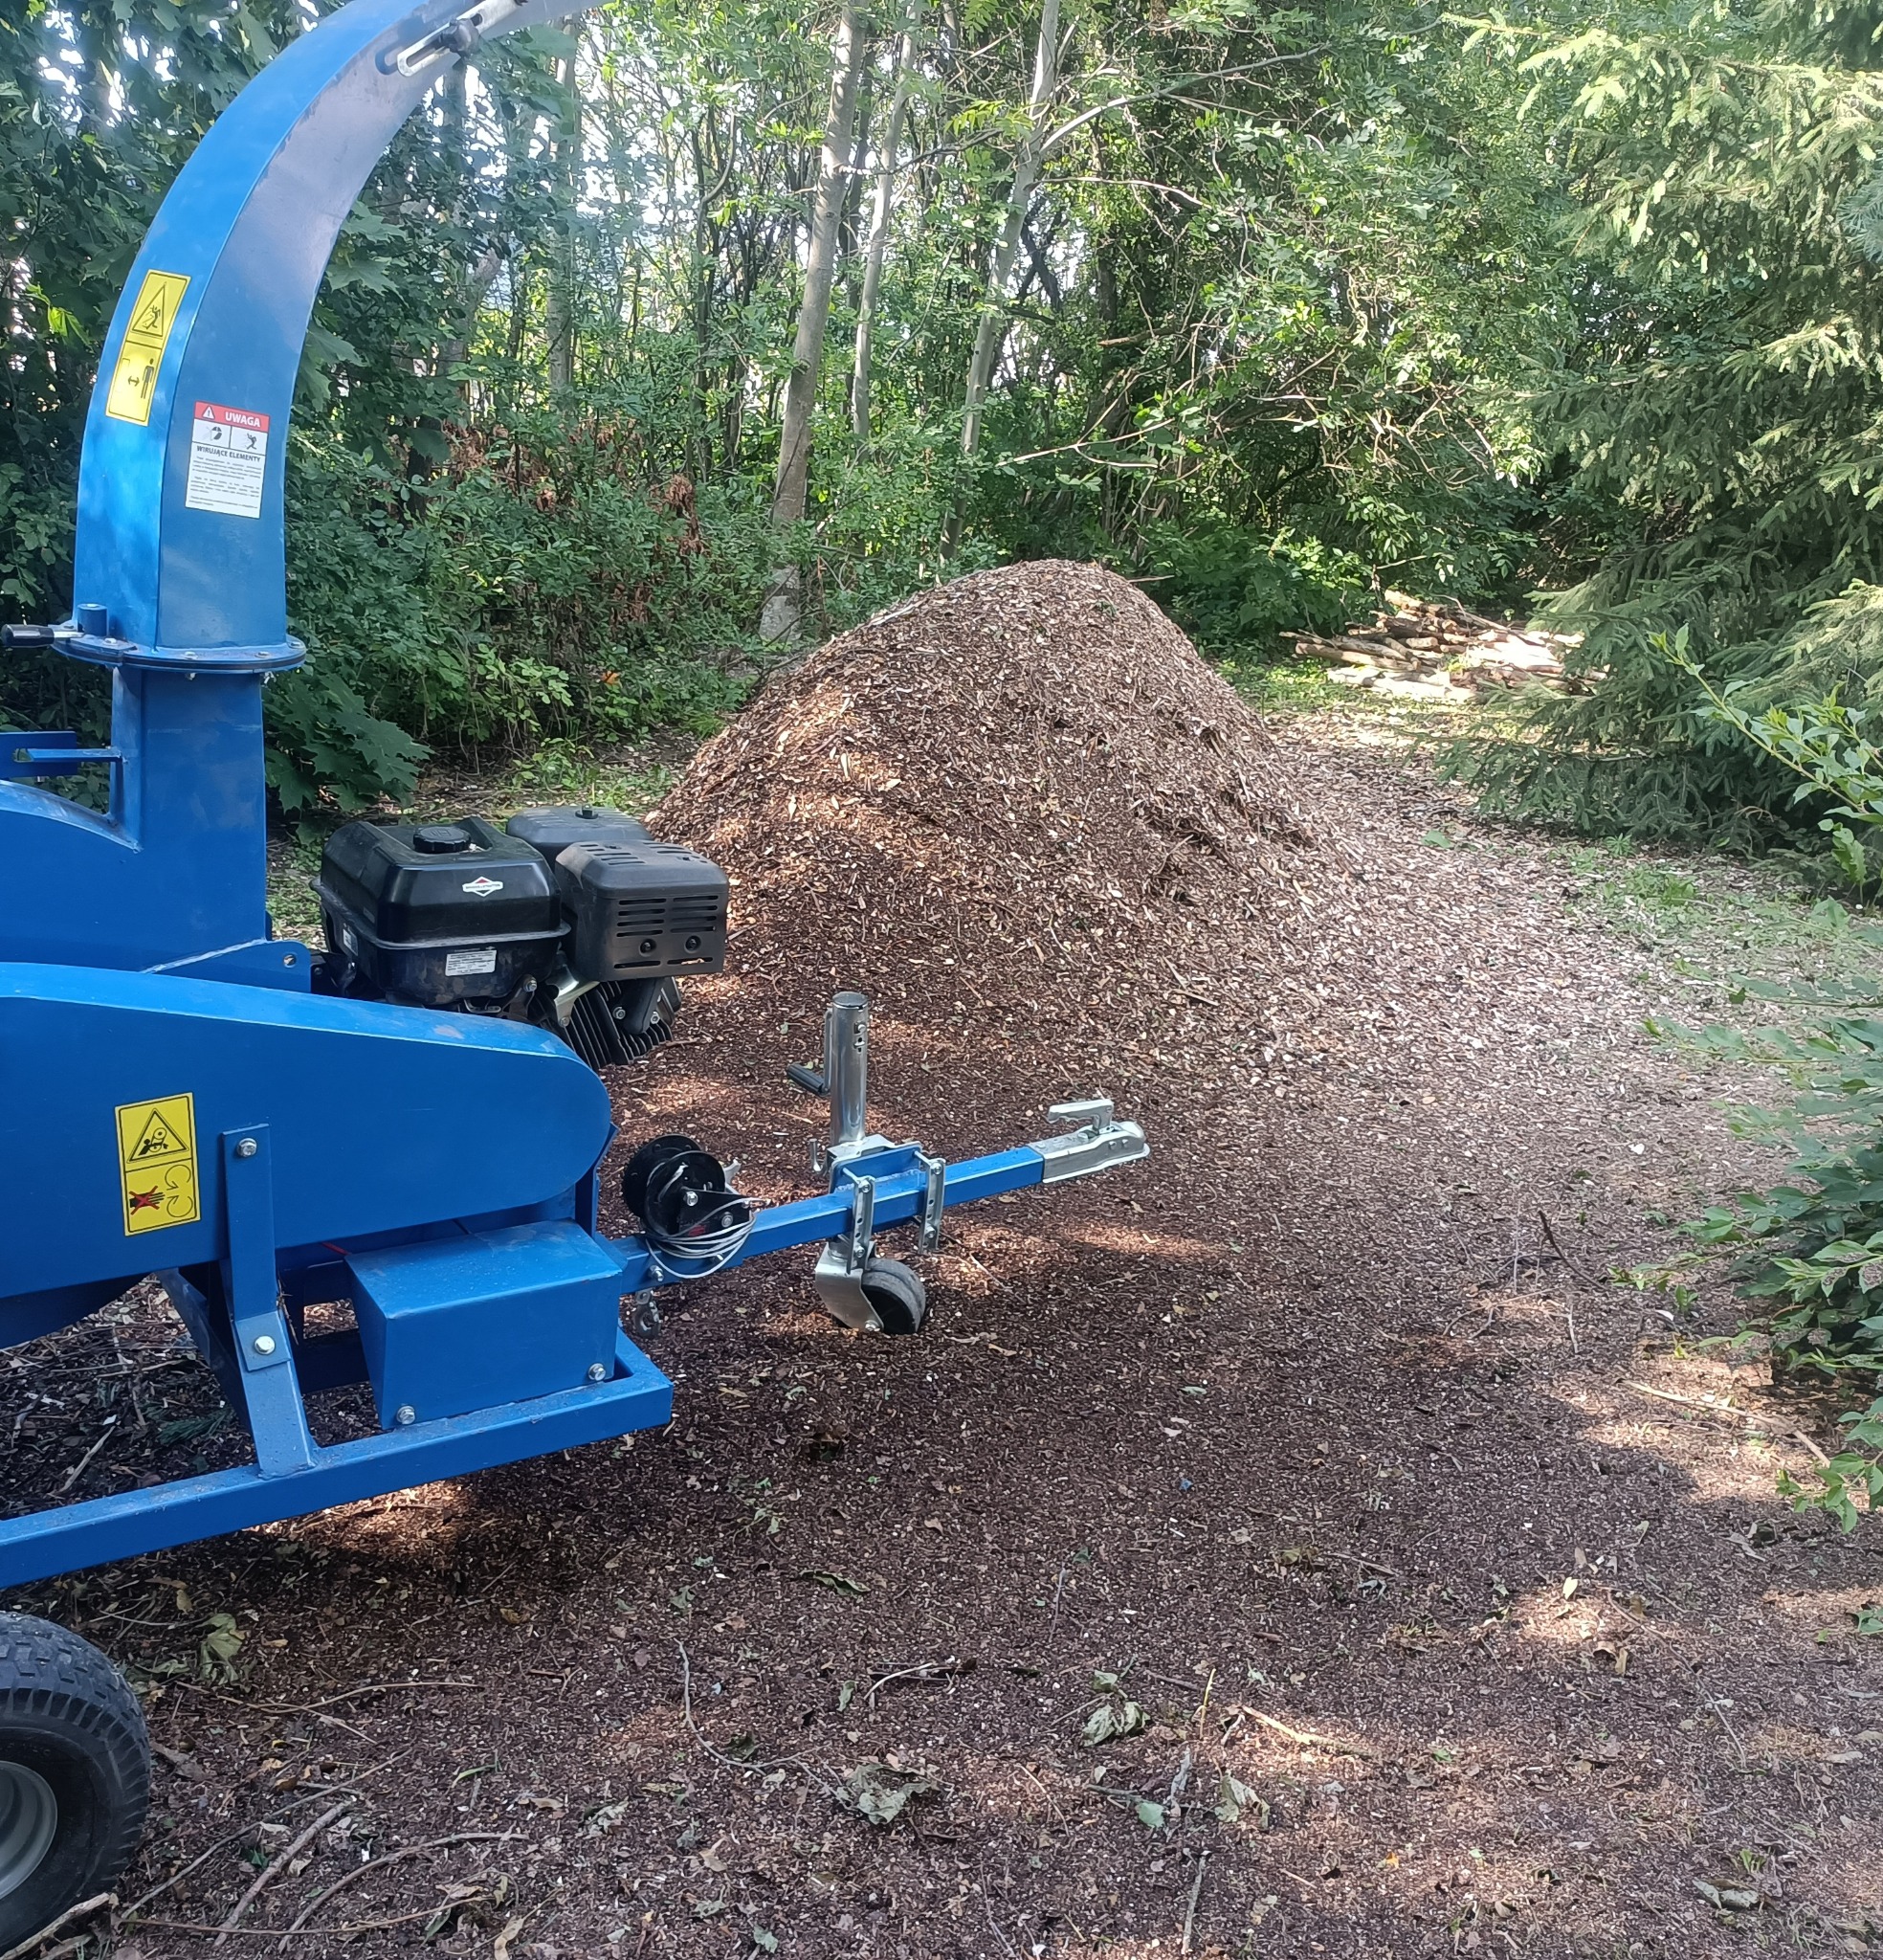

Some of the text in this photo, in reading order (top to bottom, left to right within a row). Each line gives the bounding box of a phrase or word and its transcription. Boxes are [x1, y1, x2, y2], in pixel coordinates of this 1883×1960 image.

[225, 412, 260, 427] UWAGA
[196, 445, 261, 463] WIRUJĄCE ELEMENTY
